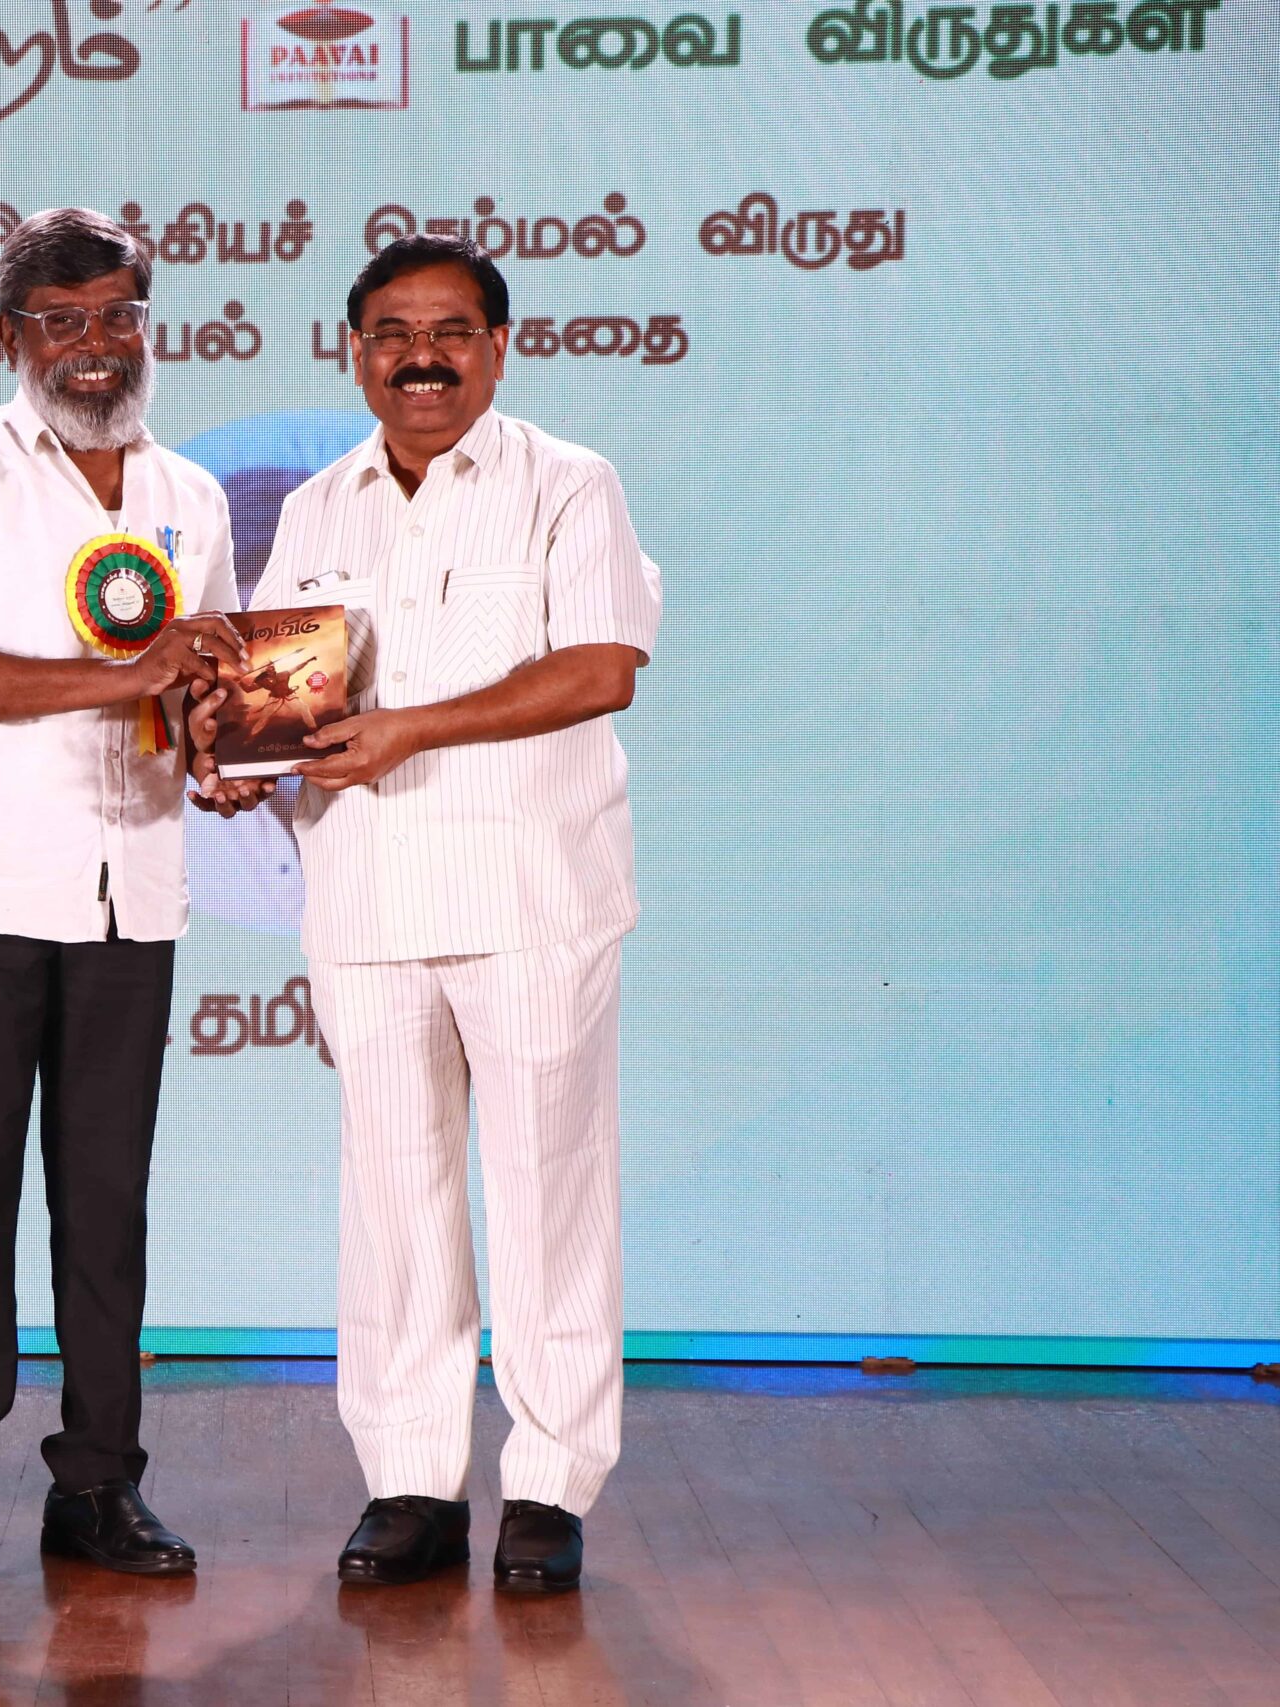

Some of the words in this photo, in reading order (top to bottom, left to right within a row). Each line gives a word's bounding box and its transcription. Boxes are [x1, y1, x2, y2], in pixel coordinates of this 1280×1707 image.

[270, 42, 379, 66] PAAVAI
[454, 13, 742, 72] பாவை
[804, 0, 1220, 79] விருதுகள
[699, 192, 906, 271] விருது
[190, 975, 336, 1069] தமி
